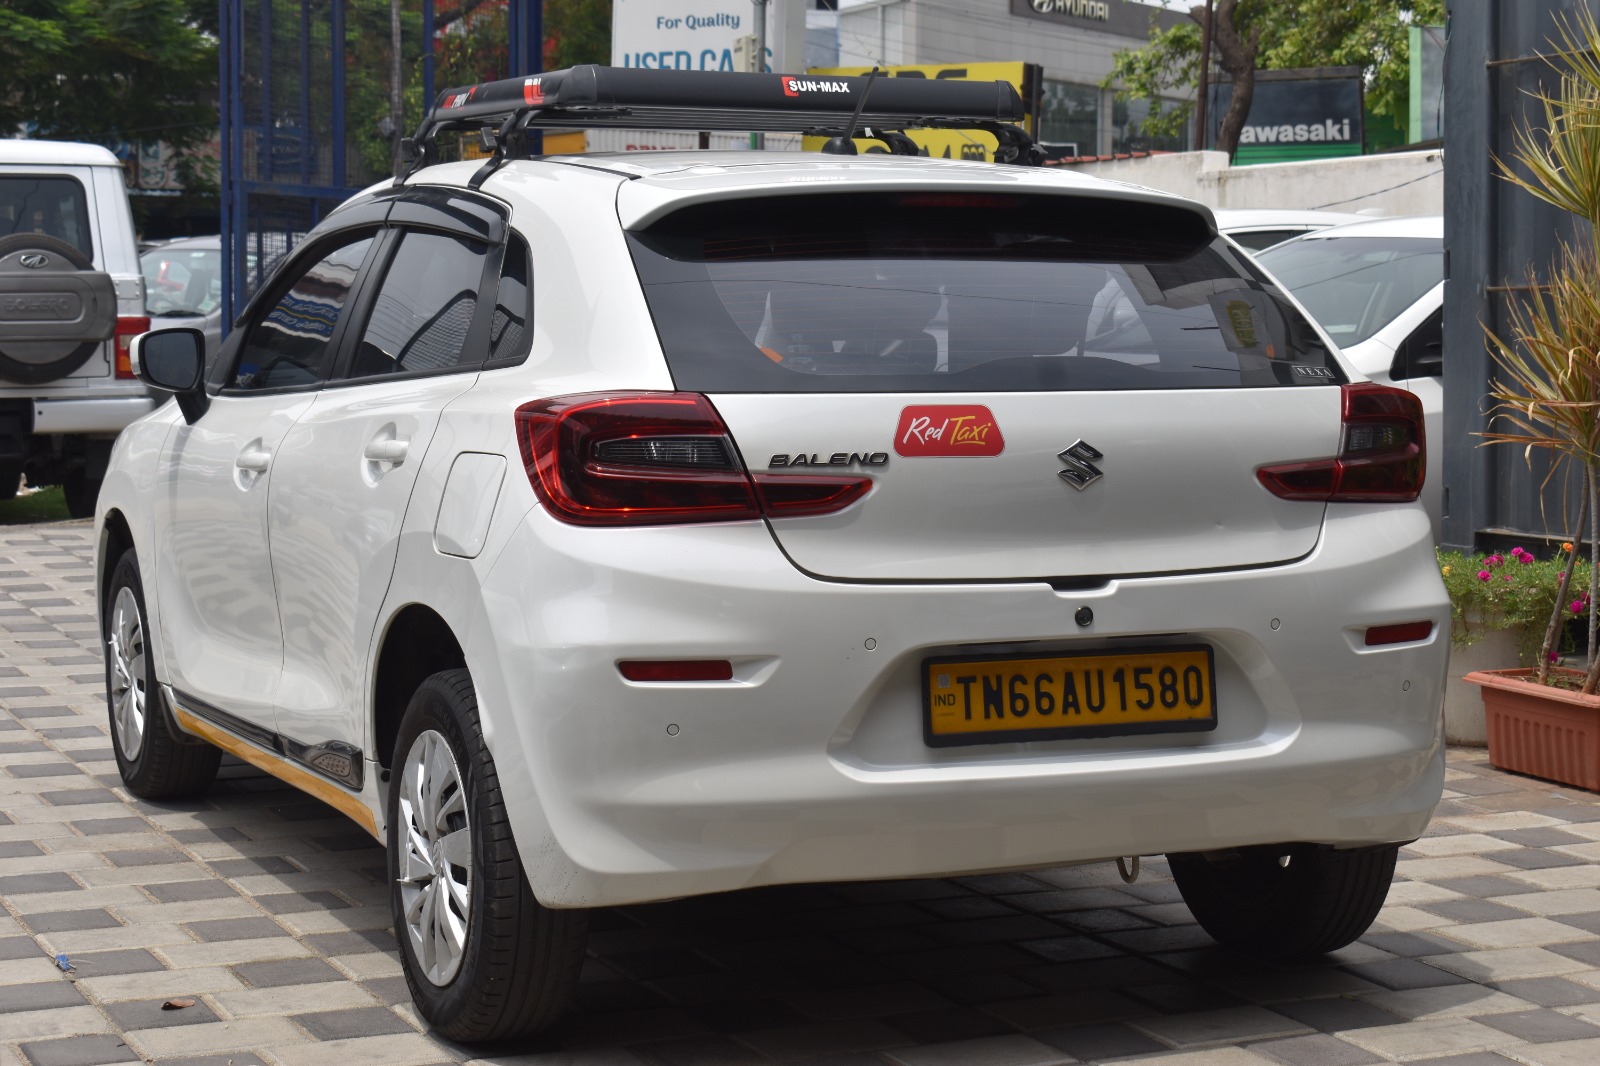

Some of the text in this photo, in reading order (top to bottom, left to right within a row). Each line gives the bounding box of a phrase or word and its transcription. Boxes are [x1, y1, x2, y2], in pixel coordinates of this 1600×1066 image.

[1055, 0, 1109, 20] HYUNDAI
[656, 13, 740, 30] For Quality
[788, 80, 850, 93] SUN-MAX
[1238, 118, 1350, 143] awasaki
[1296, 366, 1332, 377] NEXA
[902, 415, 992, 446] Red Taxi
[768, 452, 889, 468] BALENO
[934, 664, 1204, 721] IND TN66AU1580
